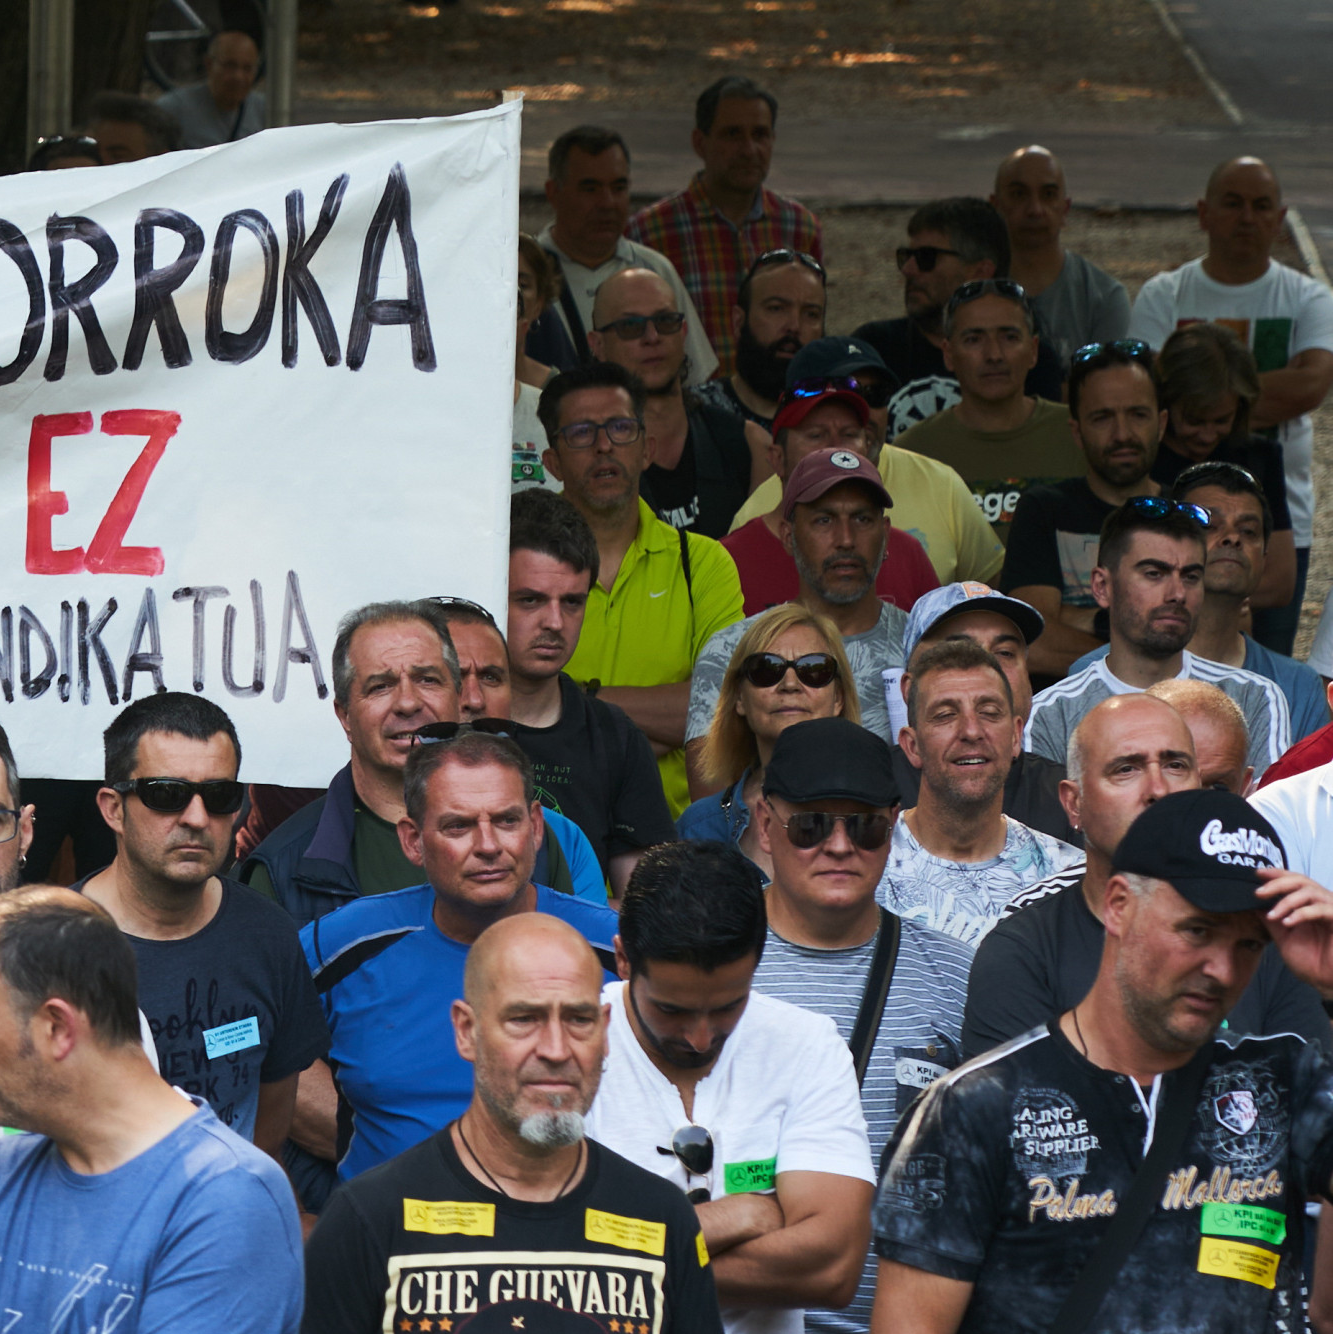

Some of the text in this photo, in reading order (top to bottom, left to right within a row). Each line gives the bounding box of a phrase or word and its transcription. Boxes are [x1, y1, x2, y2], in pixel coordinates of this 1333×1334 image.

[25, 408, 183, 577] EZ
[1028, 1164, 1284, 1223] Palma Mallorca
[400, 1269, 651, 1320] CHE GUEVARA
